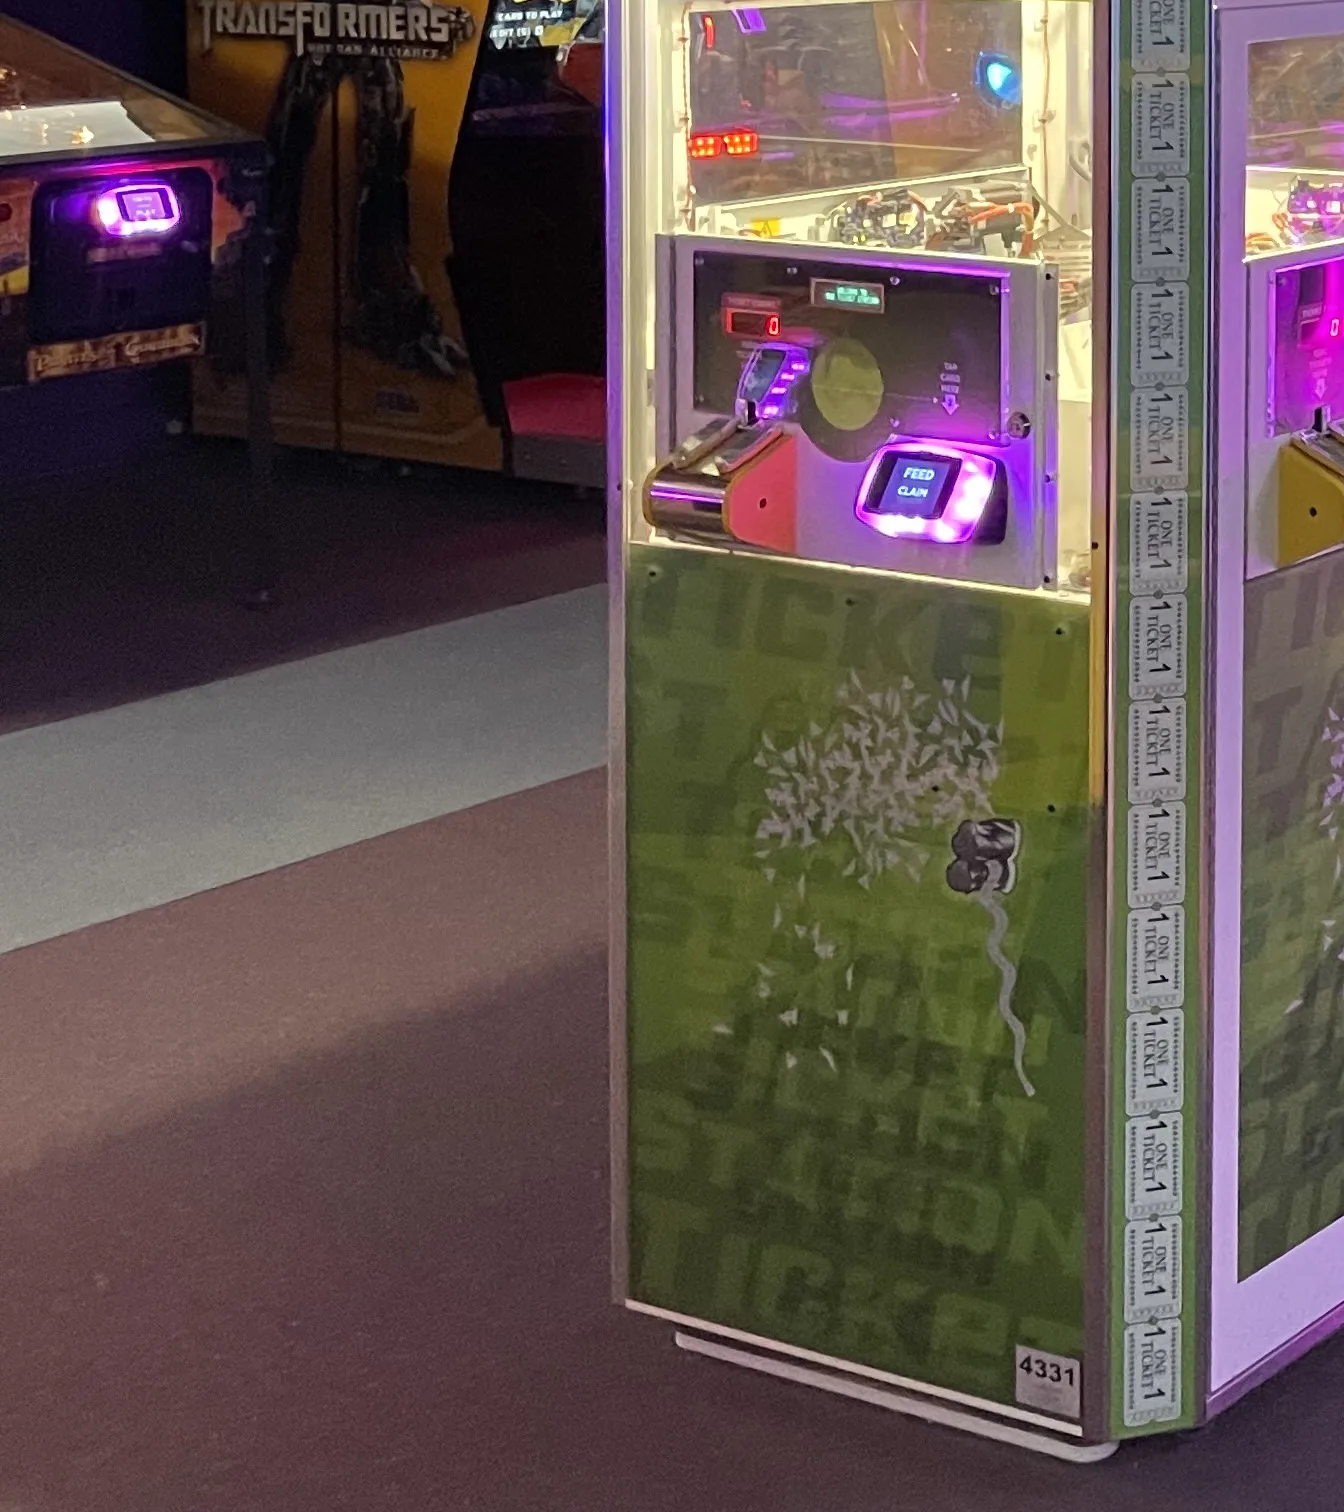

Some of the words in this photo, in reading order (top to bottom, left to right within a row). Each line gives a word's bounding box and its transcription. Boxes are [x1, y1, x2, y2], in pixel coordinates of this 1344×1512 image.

[903, 467, 935, 481] FEED
[897, 485, 929, 498] CLAIM
[1019, 1355, 1074, 1387] 4331
